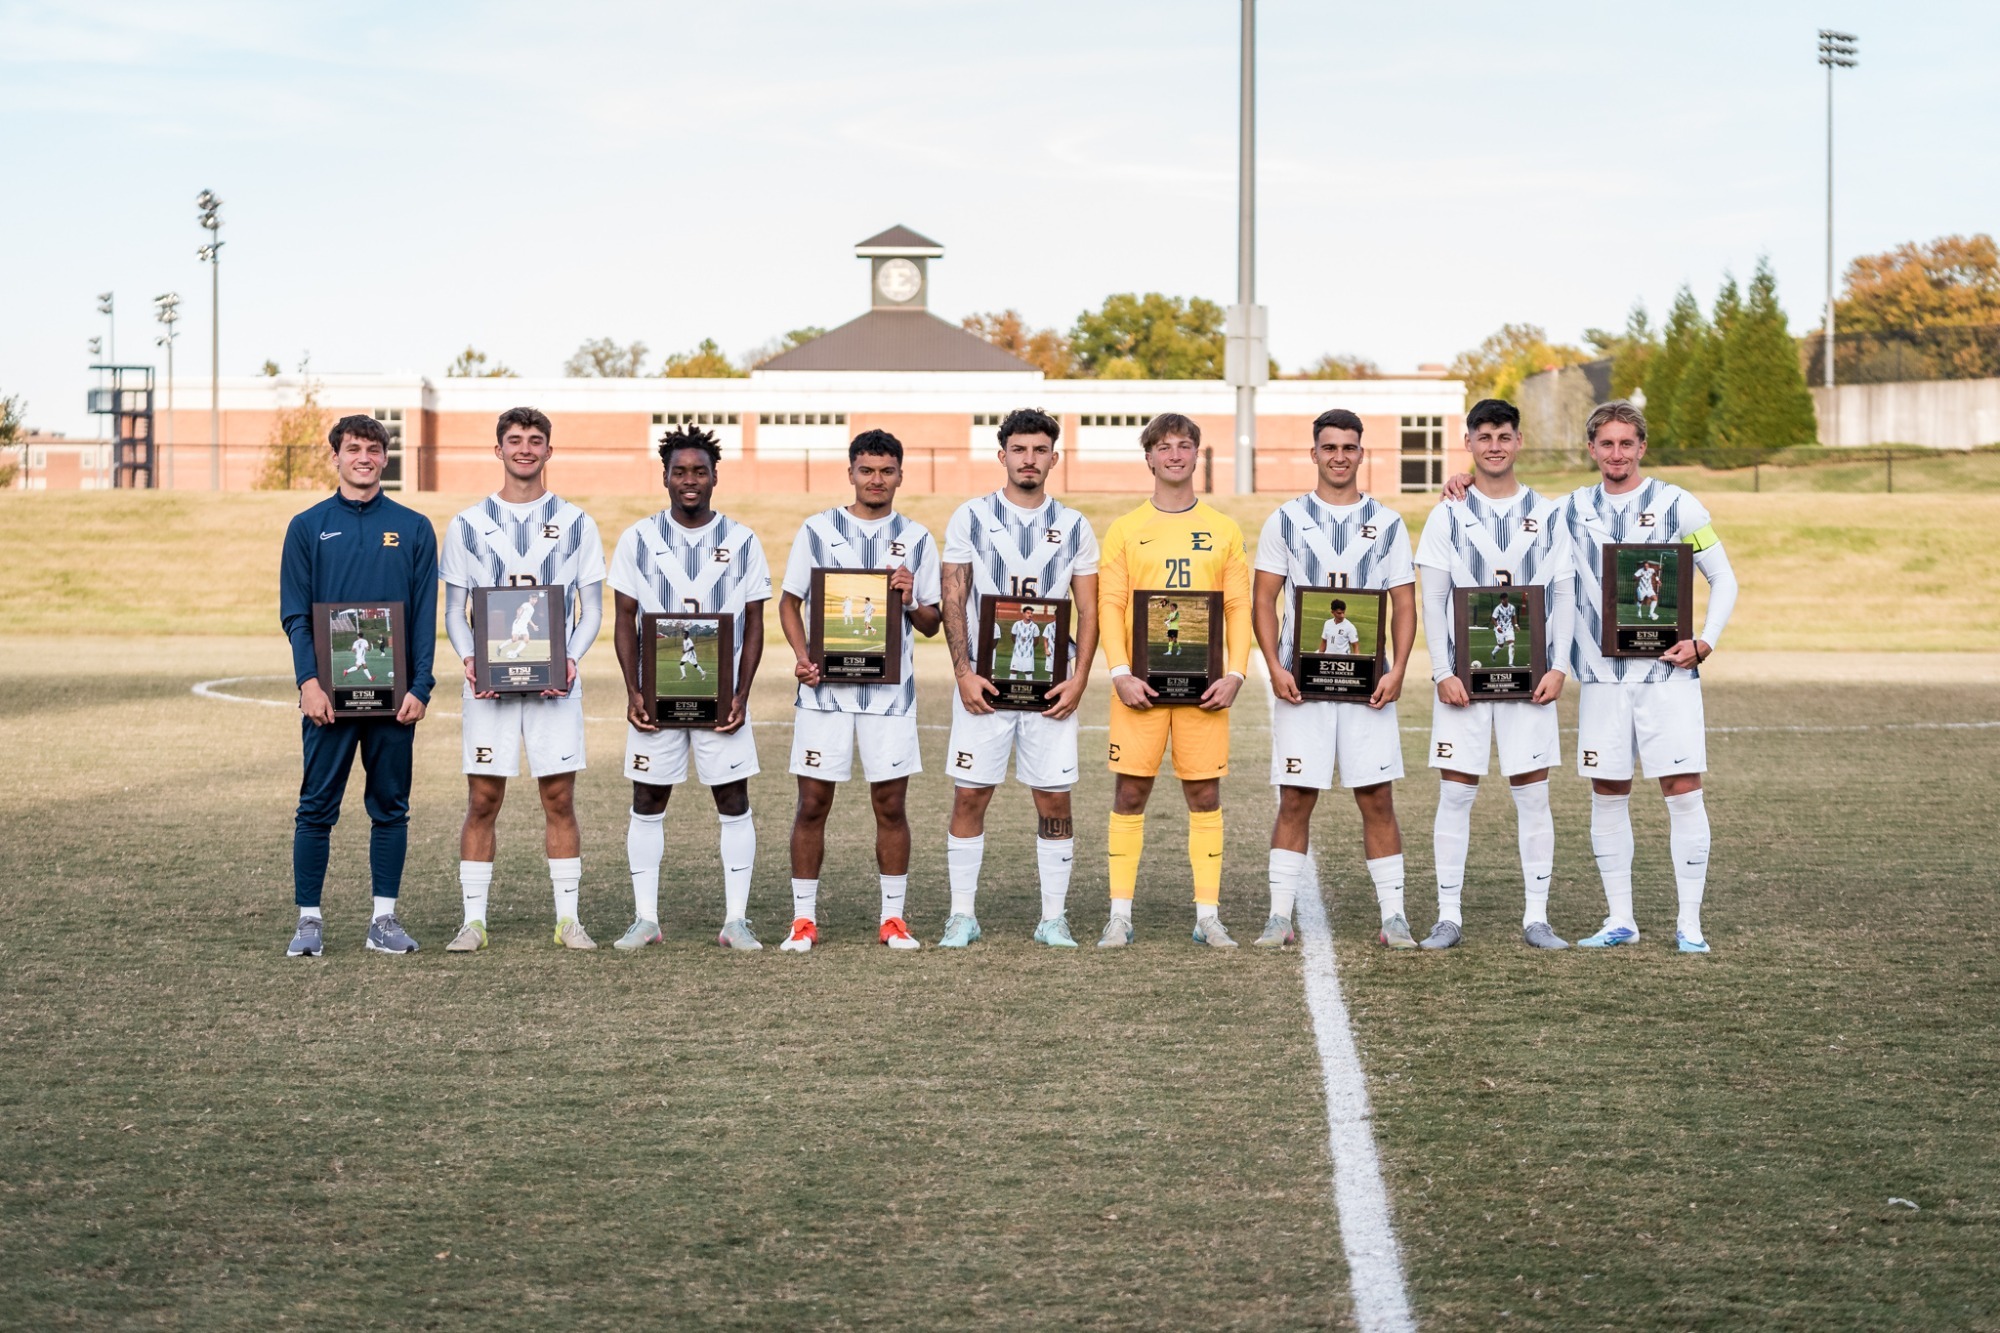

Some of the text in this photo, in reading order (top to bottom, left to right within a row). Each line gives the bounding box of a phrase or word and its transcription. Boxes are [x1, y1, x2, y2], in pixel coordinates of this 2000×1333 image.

[1523, 518, 1538, 534] E
[1639, 513, 1655, 528] E
[383, 532, 400, 547] E
[543, 524, 560, 540] E
[1047, 529, 1062, 545] E
[1361, 525, 1377, 541] E
[891, 541, 906, 557] E
[1190, 531, 1213, 552] E
[714, 548, 731, 563] E
[1165, 558, 1191, 589] 26
[1010, 575, 1037, 598] 16
[1319, 660, 1355, 672] ETSU
[476, 747, 493, 763] E
[1109, 743, 1121, 762] E
[1437, 742, 1454, 759] E
[633, 753, 650, 772] E
[805, 750, 821, 768] E
[955, 751, 974, 770] E
[1286, 757, 1303, 774] E
[1583, 750, 1599, 768] E
